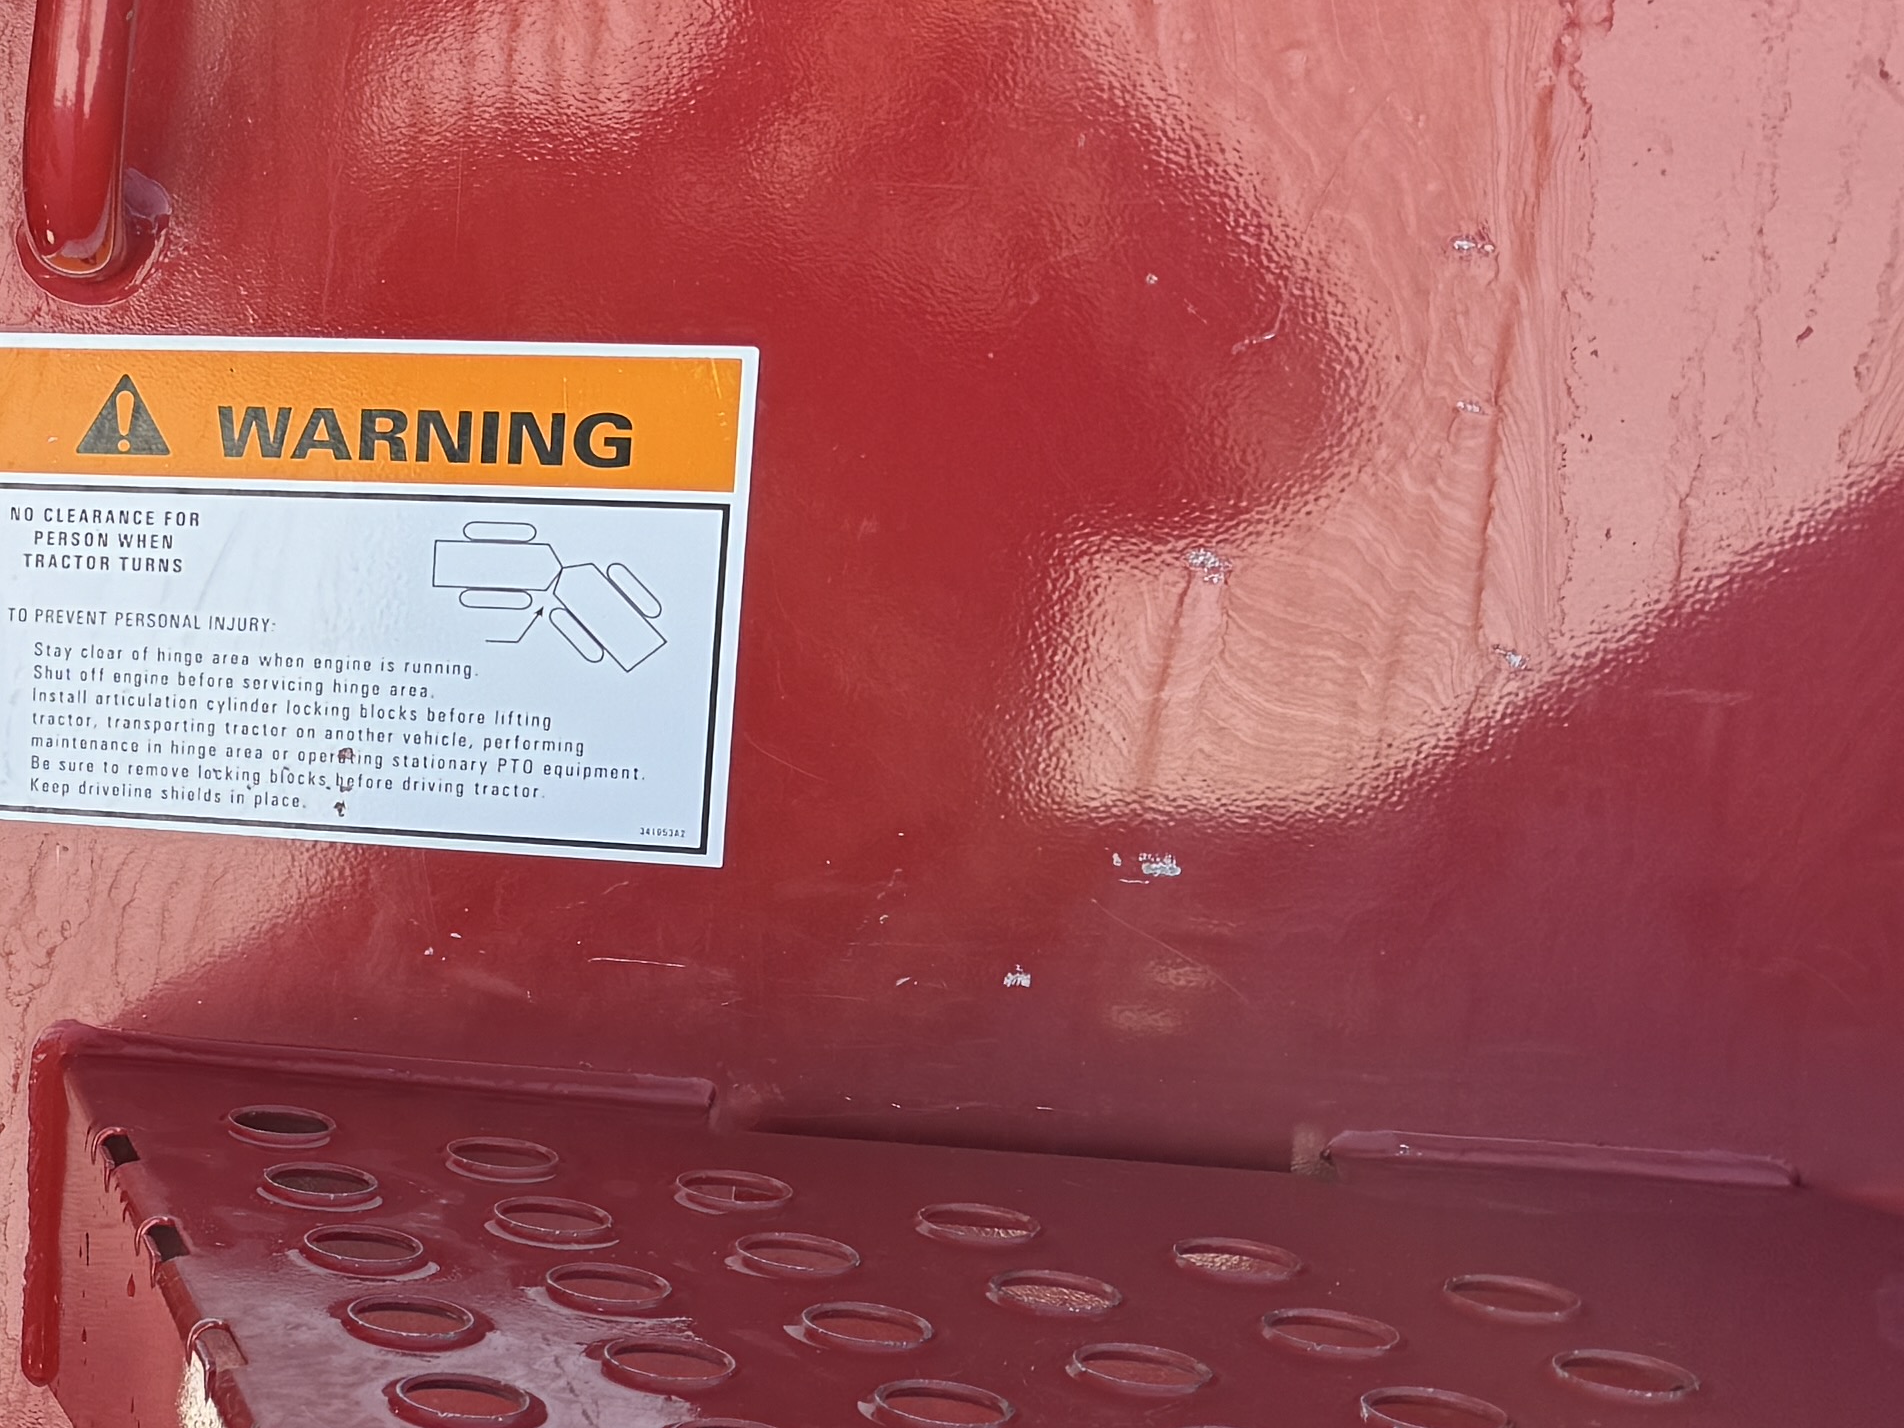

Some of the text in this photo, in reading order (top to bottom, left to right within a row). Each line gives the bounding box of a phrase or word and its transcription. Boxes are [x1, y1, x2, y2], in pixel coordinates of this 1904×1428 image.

[218, 404, 633, 469] WARNING
[10, 507, 200, 527] NO CLEARANCE FOR
[34, 531, 173, 549] PERSON WHEN
[24, 553, 183, 573] TRACTOR TURNS
[8, 608, 27, 622] TO
[35, 609, 107, 625] PREVENT
[115, 612, 200, 630] PERSONAL
[34, 642, 478, 679] Stay clear of hinge area when engine is running.
[34, 665, 434, 699] Shut off engine before servicing hinge area.
[33, 688, 551, 731] Install articulation cylinder locking blocks before lifting
[33, 713, 584, 757] tractor, transporting tractor on another vehicle, performing
[32, 736, 139, 752] maintenance
[148, 740, 161, 754] in
[171, 742, 216, 759] hinge
[226, 748, 263, 759] area
[272, 749, 288, 760] or
[392, 755, 487, 775] stationary
[498, 759, 533, 774] PTO
[543, 763, 645, 780] equipment.
[31, 756, 545, 798] Be sure to remove locking blocks before driving tractor.
[31, 778, 306, 808] Keep driveline shields in place.
